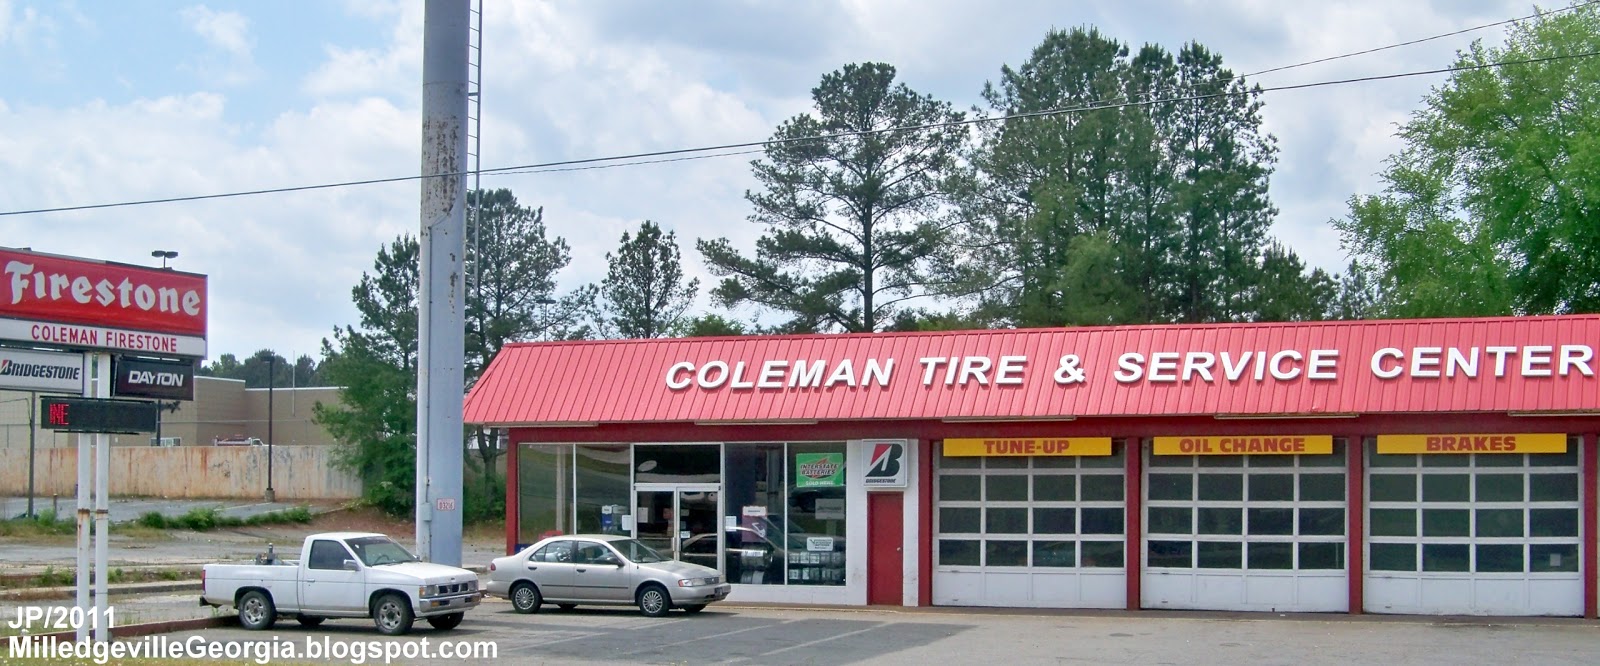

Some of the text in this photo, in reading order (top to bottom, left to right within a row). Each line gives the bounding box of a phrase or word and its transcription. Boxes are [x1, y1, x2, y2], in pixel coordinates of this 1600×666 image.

[5, 261, 200, 316] Firestone
[32, 325, 177, 353] COLEMAN FIRESTONE
[0, 359, 80, 380] BRIDGESTONE
[665, 344, 1595, 390] COLEMAN TIRE & SERVICE CENTER
[128, 370, 184, 387] DAYTON
[983, 439, 1070, 454] TUNE-UP
[1179, 437, 1305, 453] OIL CHANGE
[1426, 436, 1516, 451] BRAKES
